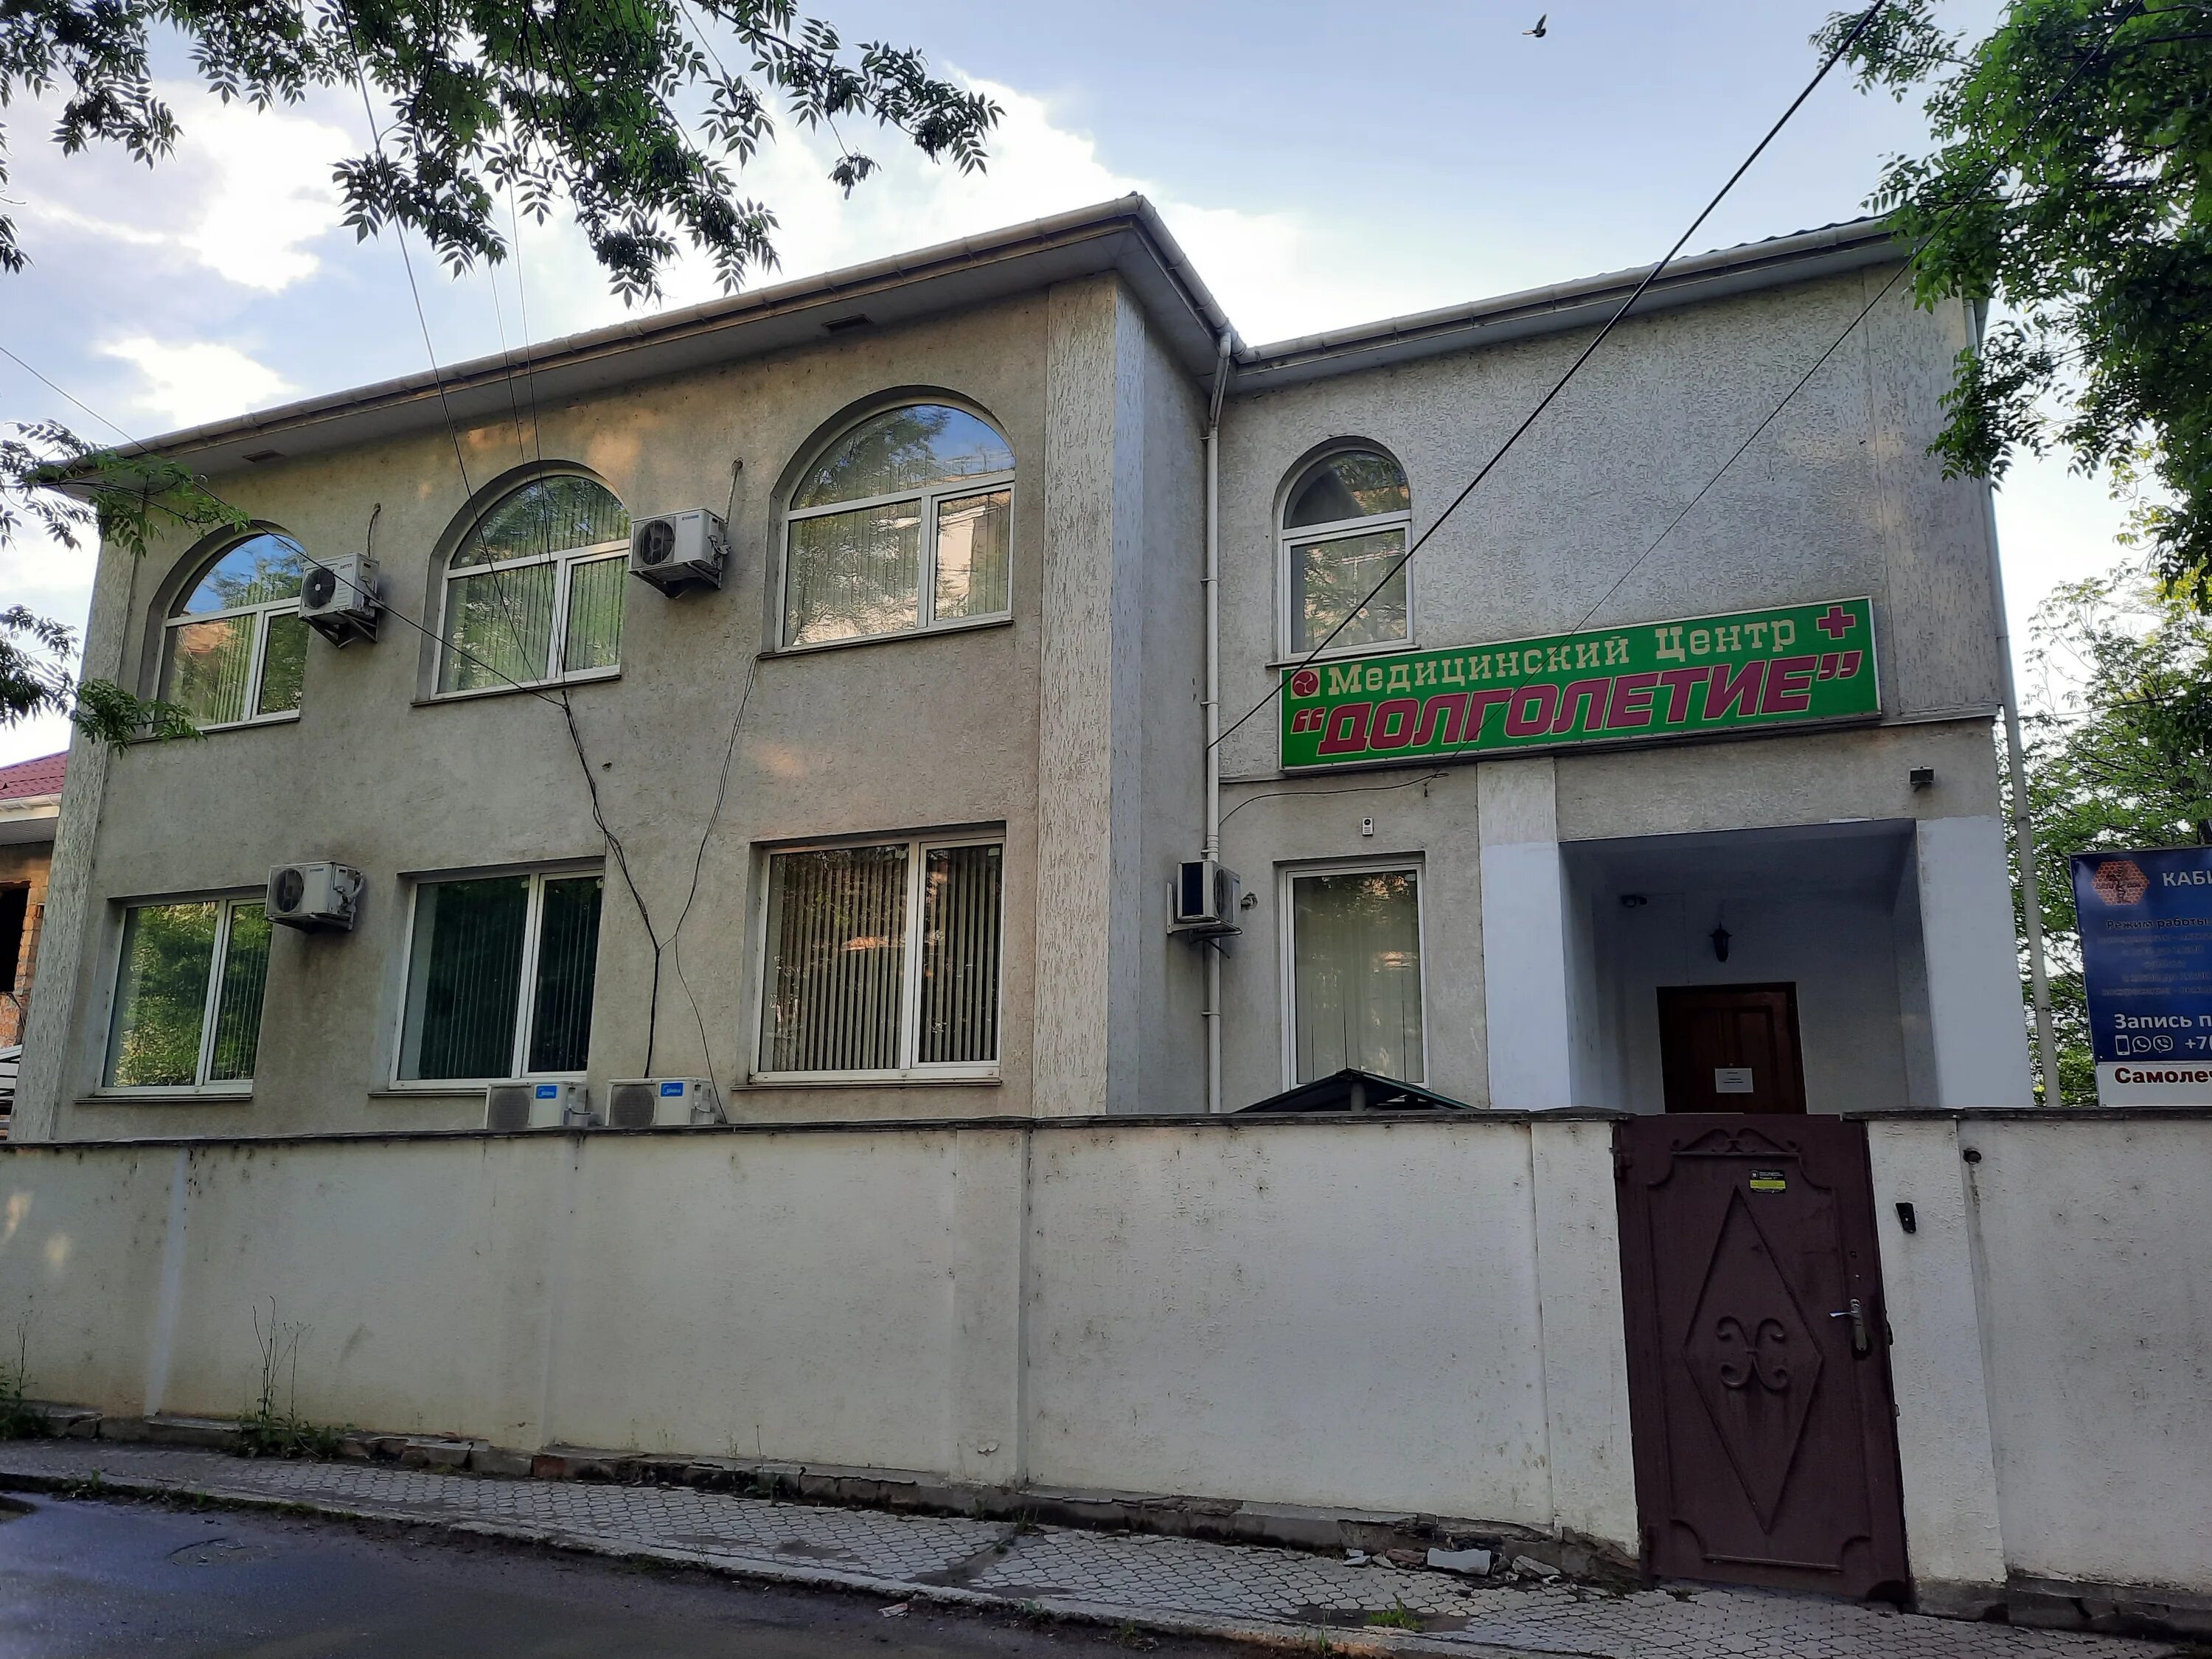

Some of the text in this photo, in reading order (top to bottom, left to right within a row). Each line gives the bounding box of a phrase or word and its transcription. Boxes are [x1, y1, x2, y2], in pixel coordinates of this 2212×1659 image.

[1328, 619, 1795, 695] Медицинский Центр
[2107, 917, 2207, 929] Режим работы
[2114, 1014, 2193, 1029] Запись
